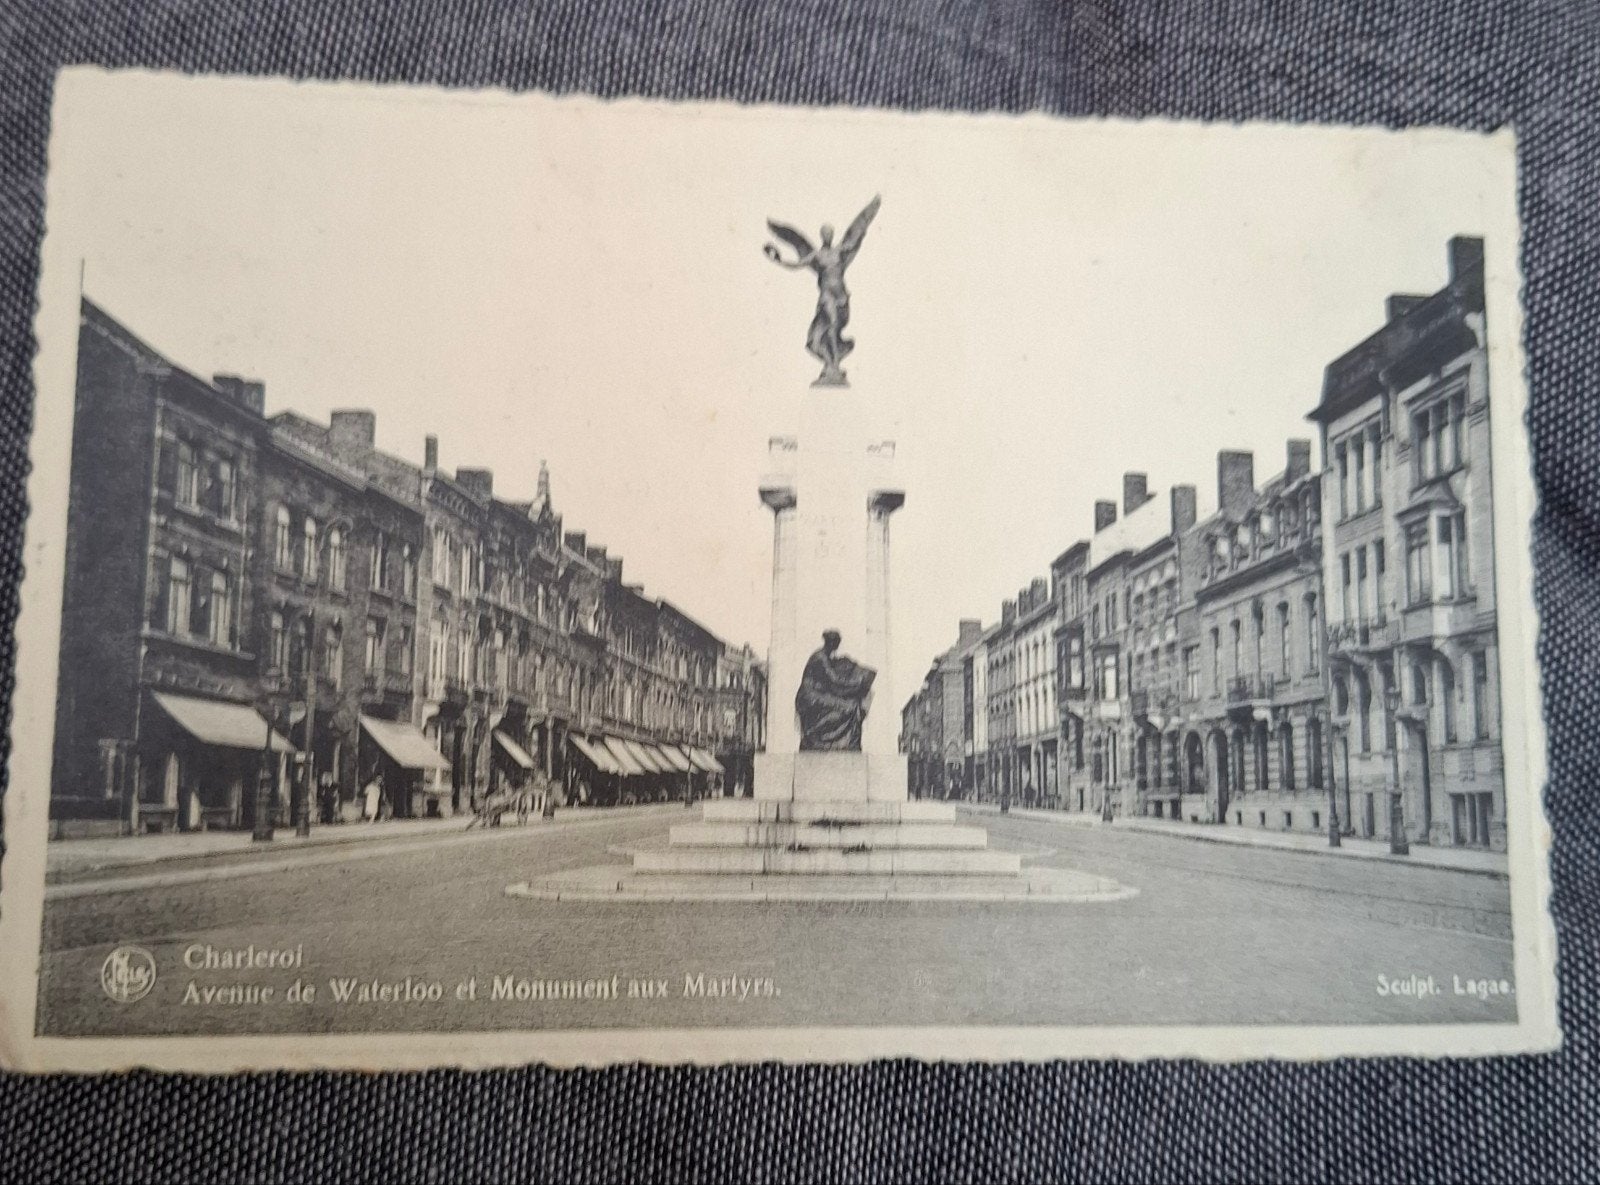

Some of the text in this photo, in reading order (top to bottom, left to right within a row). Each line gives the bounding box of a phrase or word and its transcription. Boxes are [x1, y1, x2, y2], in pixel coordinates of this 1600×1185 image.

[181, 979, 275, 1006] Avenue
[286, 978, 317, 1004] de
[328, 976, 443, 1004] Waterloo
[455, 977, 477, 1002] et
[490, 975, 619, 1001] Monument
[627, 978, 670, 999] aux
[1376, 972, 1441, 1000] Sculpt.
